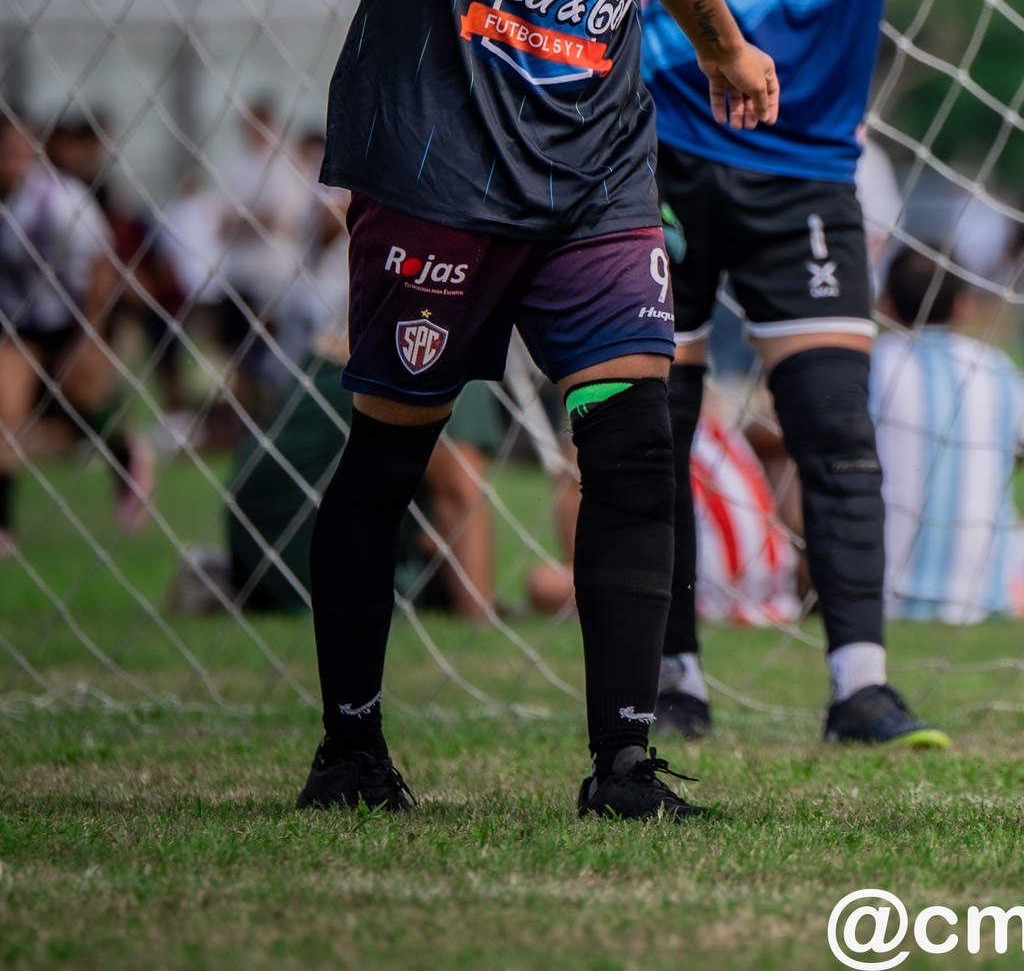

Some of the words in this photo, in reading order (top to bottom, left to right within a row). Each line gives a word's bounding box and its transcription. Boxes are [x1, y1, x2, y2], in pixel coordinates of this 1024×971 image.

[484, 13, 552, 53] FUTBOL
[552, 38, 561, 54] 5
[562, 41, 575, 57] Y
[575, 45, 584, 59] 7
[650, 247, 669, 304] 9
[402, 326, 440, 366] SPC
